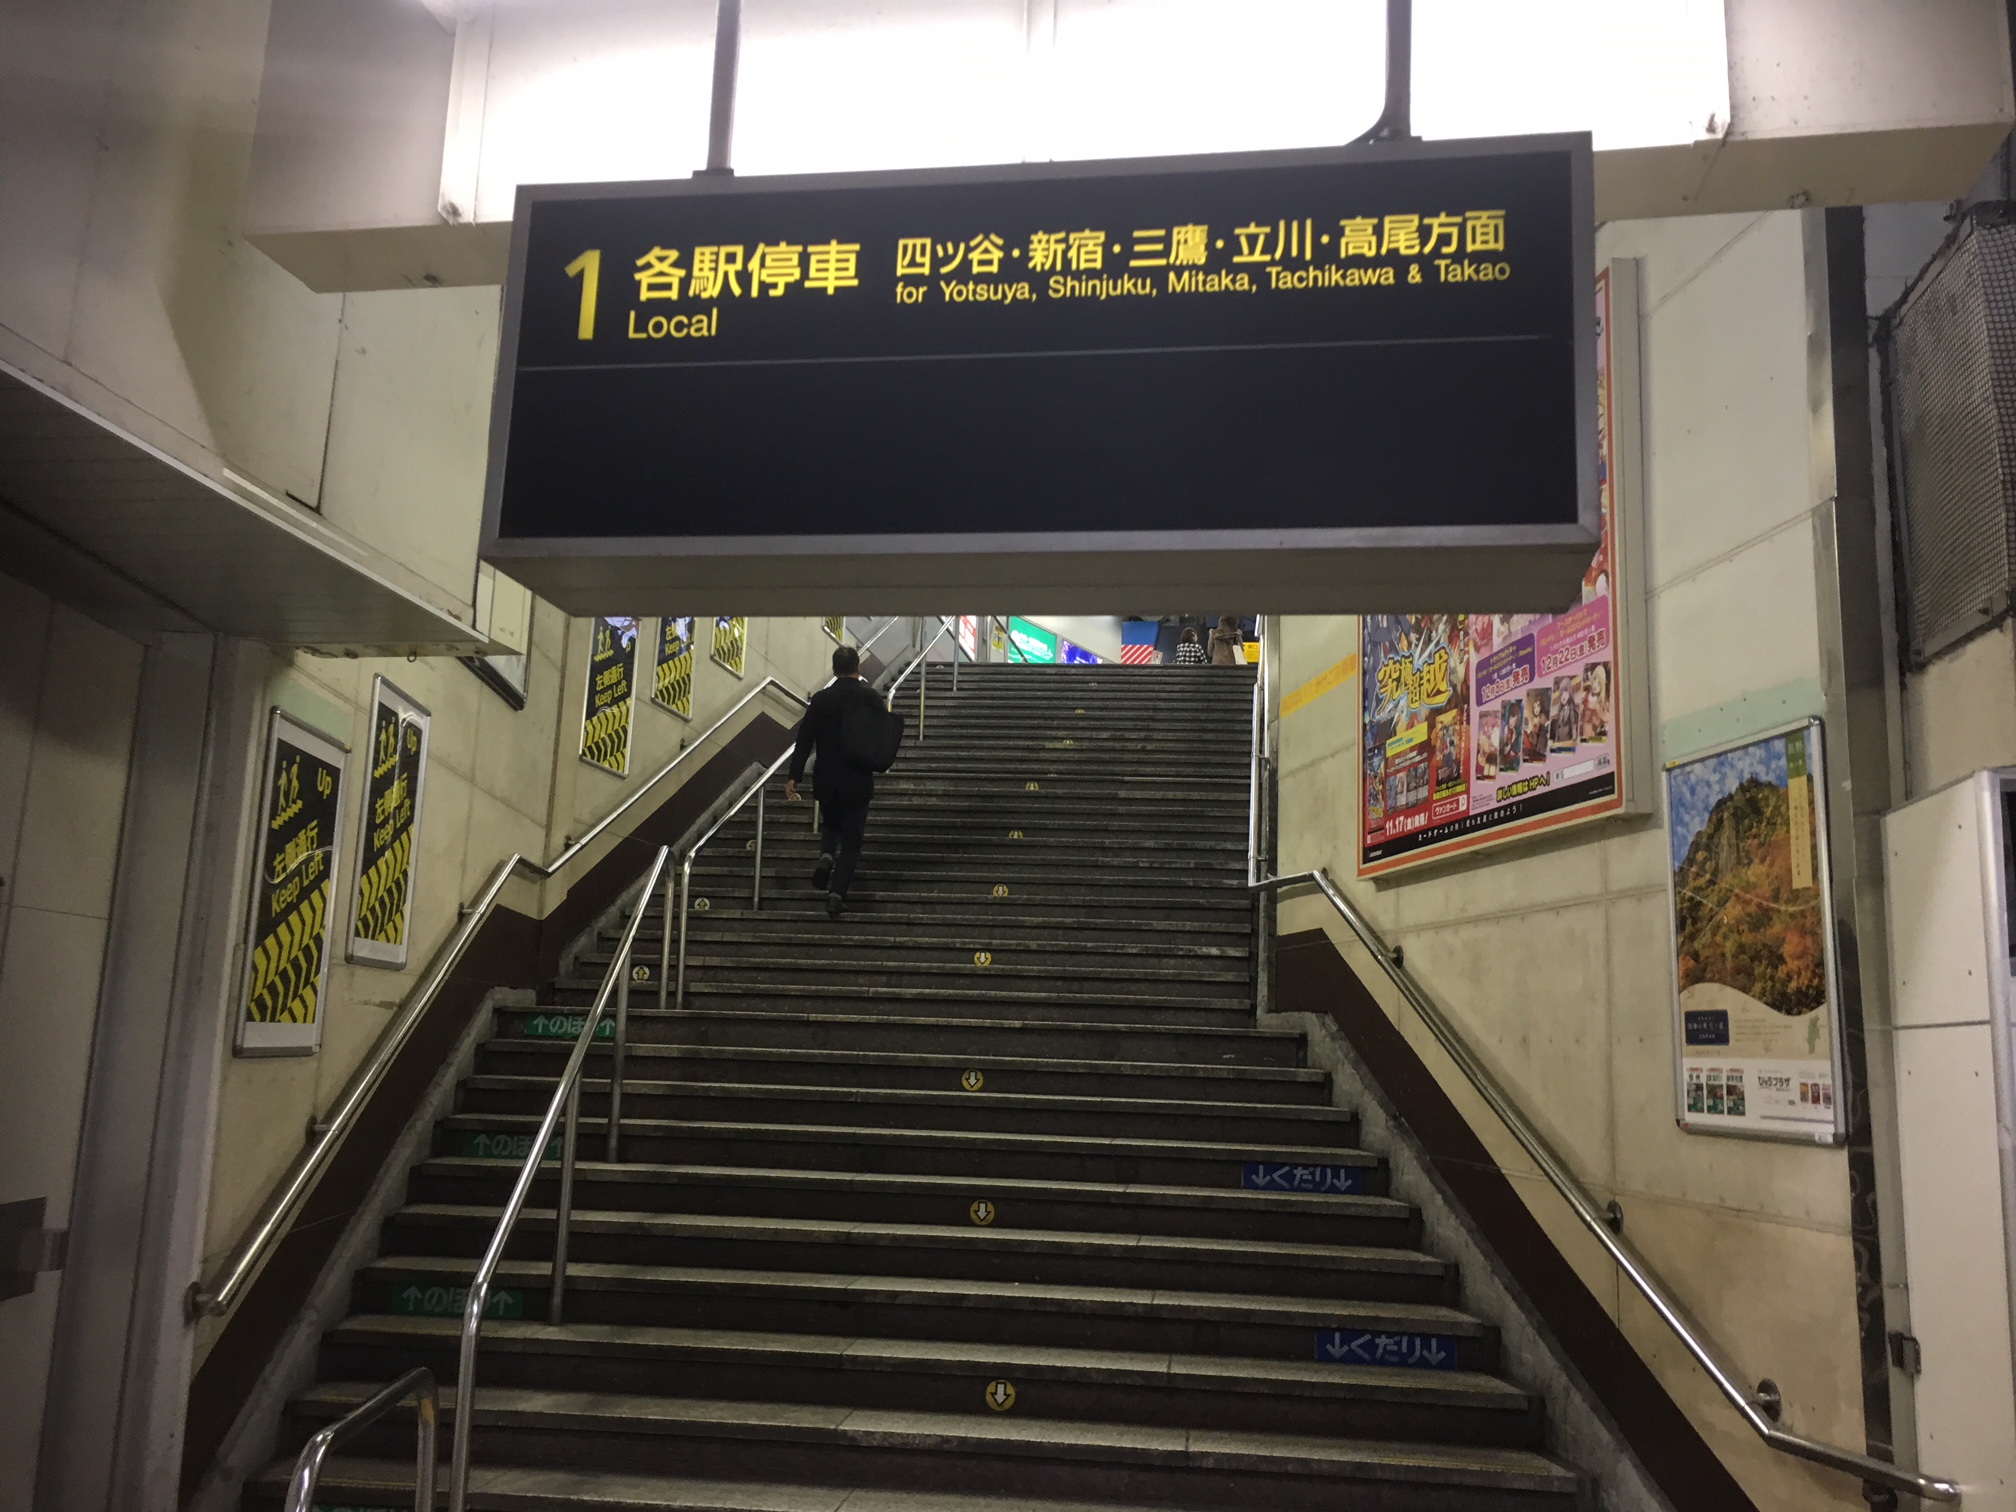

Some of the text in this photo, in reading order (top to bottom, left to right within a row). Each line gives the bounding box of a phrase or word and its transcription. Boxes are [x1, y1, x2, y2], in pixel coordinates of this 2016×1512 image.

[632, 238, 861, 303] 各駅停車
[895, 257, 1511, 305] for Yotsuya, Shinjuku, Mitaka, Tachikawa & Takao
[564, 248, 601, 340] 1
[627, 306, 718, 340] Local
[595, 663, 625, 691] 左側通行
[595, 679, 628, 708] Keep Left
[405, 727, 418, 755] Up
[316, 767, 333, 800] Up
[374, 772, 408, 825] 左側通行
[373, 803, 411, 853] Keep Left
[272, 820, 319, 884] 左側通行
[271, 846, 325, 919] Keep Left
[549, 1014, 590, 1035] のぼ
[1271, 1164, 1333, 1192] くだり
[1350, 1332, 1422, 1365] くだり
